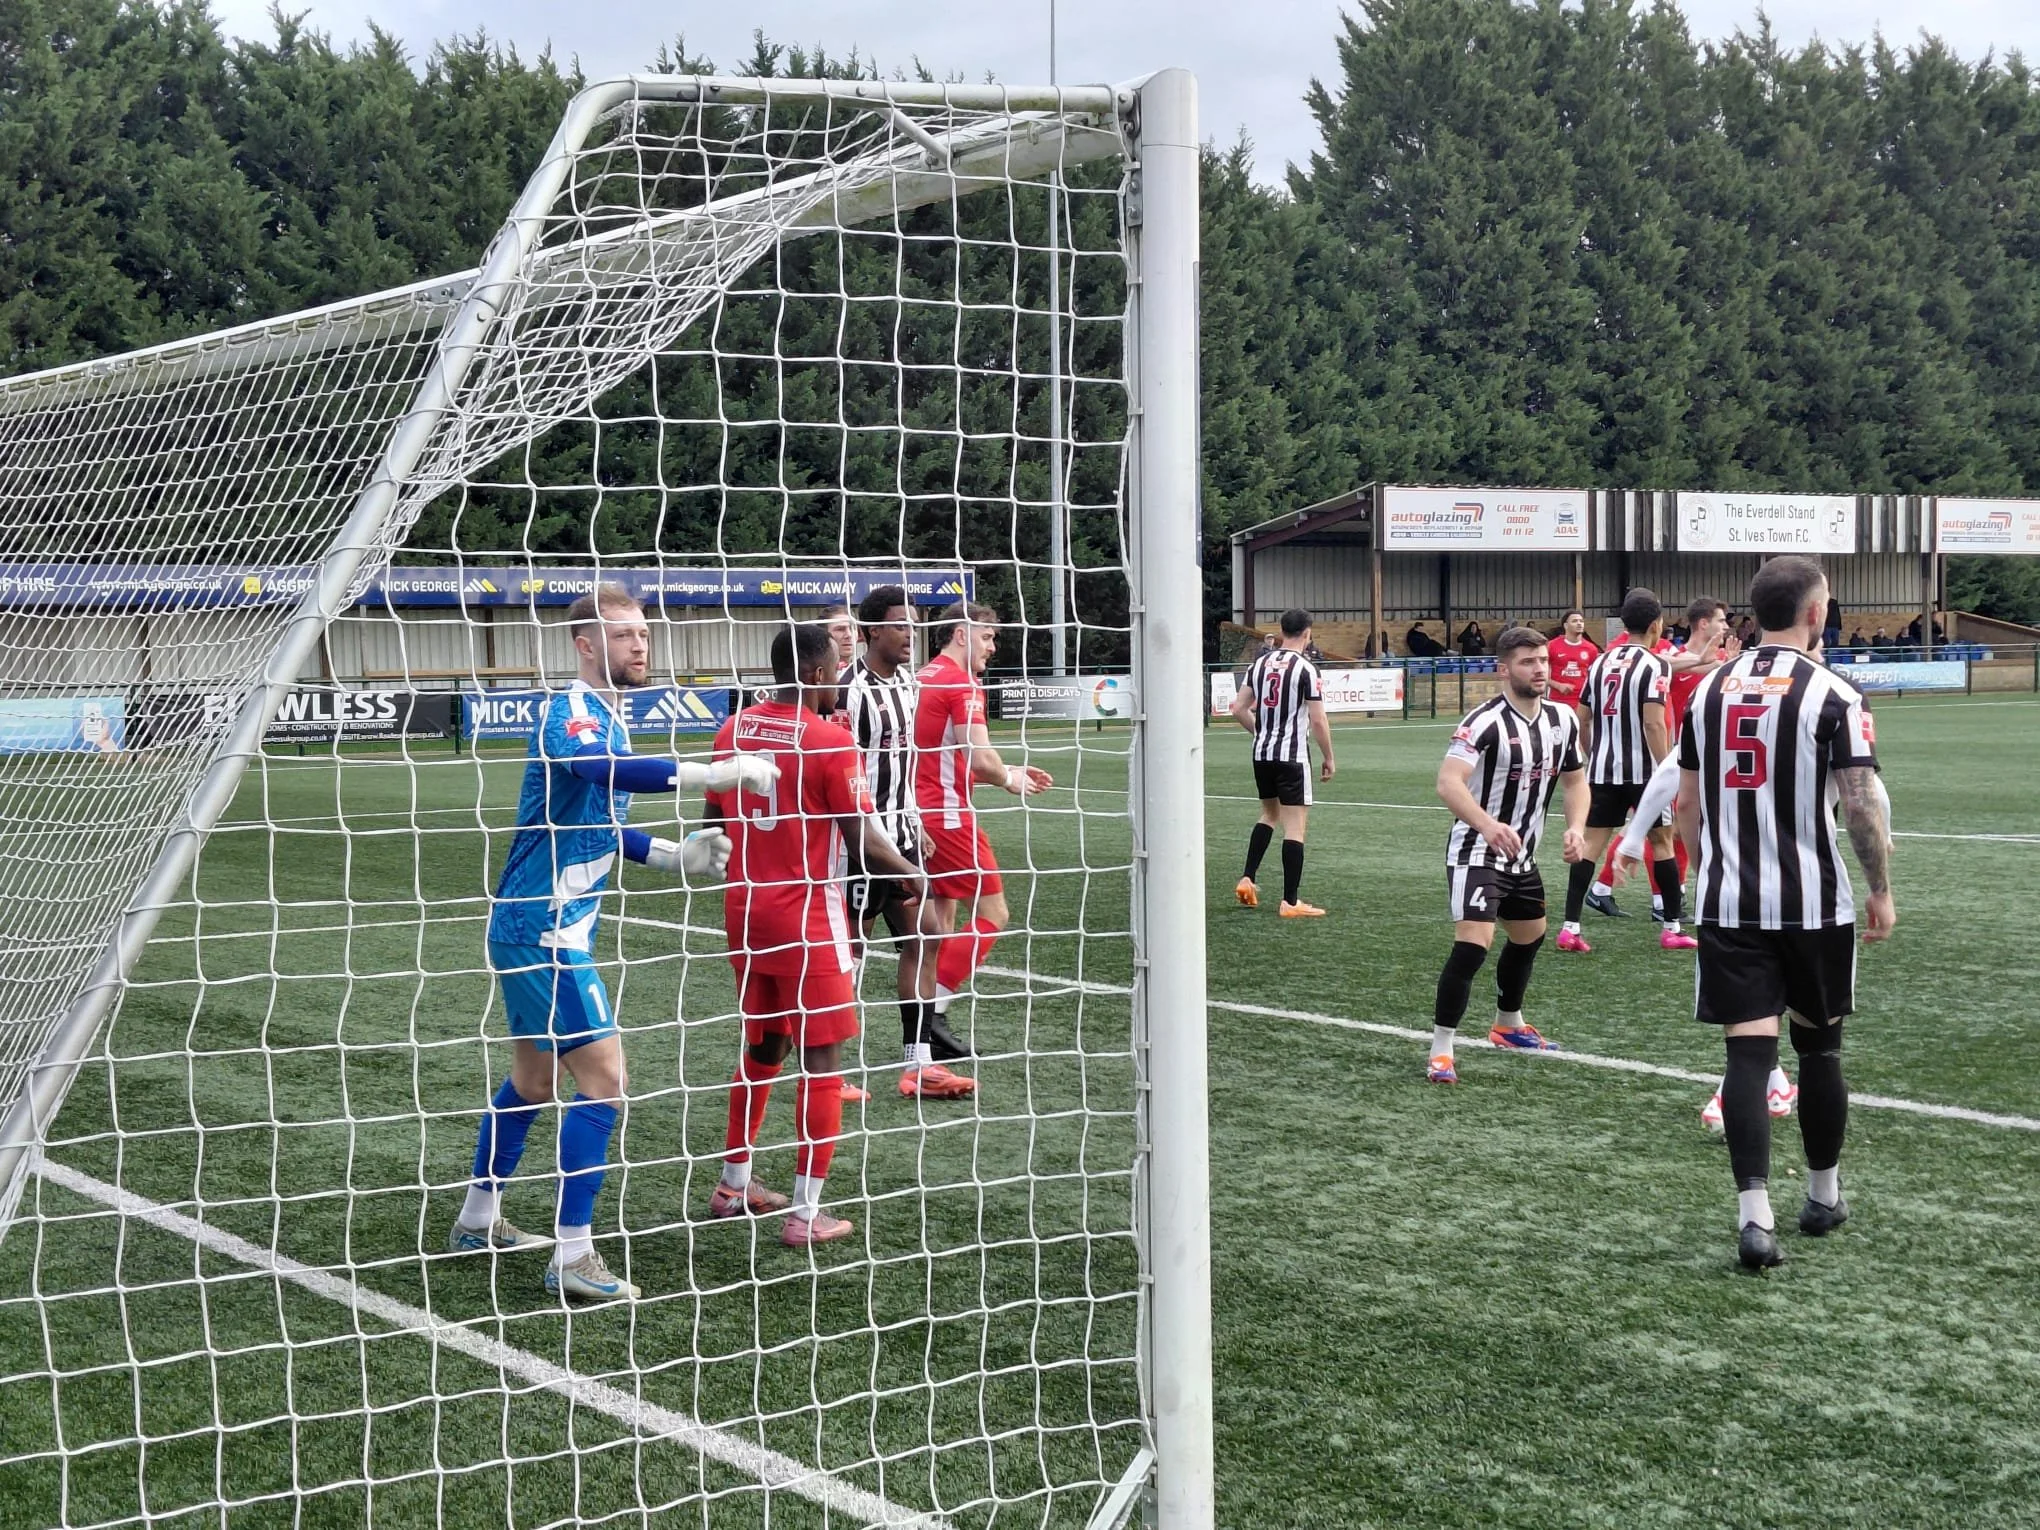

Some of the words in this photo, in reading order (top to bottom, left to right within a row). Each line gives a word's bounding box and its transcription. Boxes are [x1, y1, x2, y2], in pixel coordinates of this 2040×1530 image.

[1497, 504, 1518, 513] CALL
[1519, 505, 1540, 513] FREE
[1724, 503, 1743, 518] The
[1746, 504, 1785, 519] Everdell
[1788, 505, 1815, 520] Stand
[1391, 511, 1473, 525] autoglazing
[1942, 519, 2003, 531] autoglazing
[1554, 526, 1579, 535] ADAS
[1728, 527, 1742, 542] St.
[1744, 528, 1765, 543] Ives
[1767, 528, 1793, 543] Town
[1795, 529, 1812, 544] F.C.
[17, 577, 56, 592] HIRE
[380, 580, 410, 593] MICK
[412, 580, 458, 593] GEORGE
[641, 581, 745, 595] www.mickgeorge.co.uk
[787, 581, 821, 594] MUCK
[823, 582, 857, 594] AWAY
[1030, 688, 1037, 698] &
[1037, 687, 1081, 698] DISPLAYS
[1262, 671, 1282, 709] 3
[1602, 673, 1622, 717] 2
[471, 700, 534, 724] MICK
[1724, 704, 1771, 789] 5
[1469, 886, 1488, 912] 4
[588, 983, 608, 1023] 1
